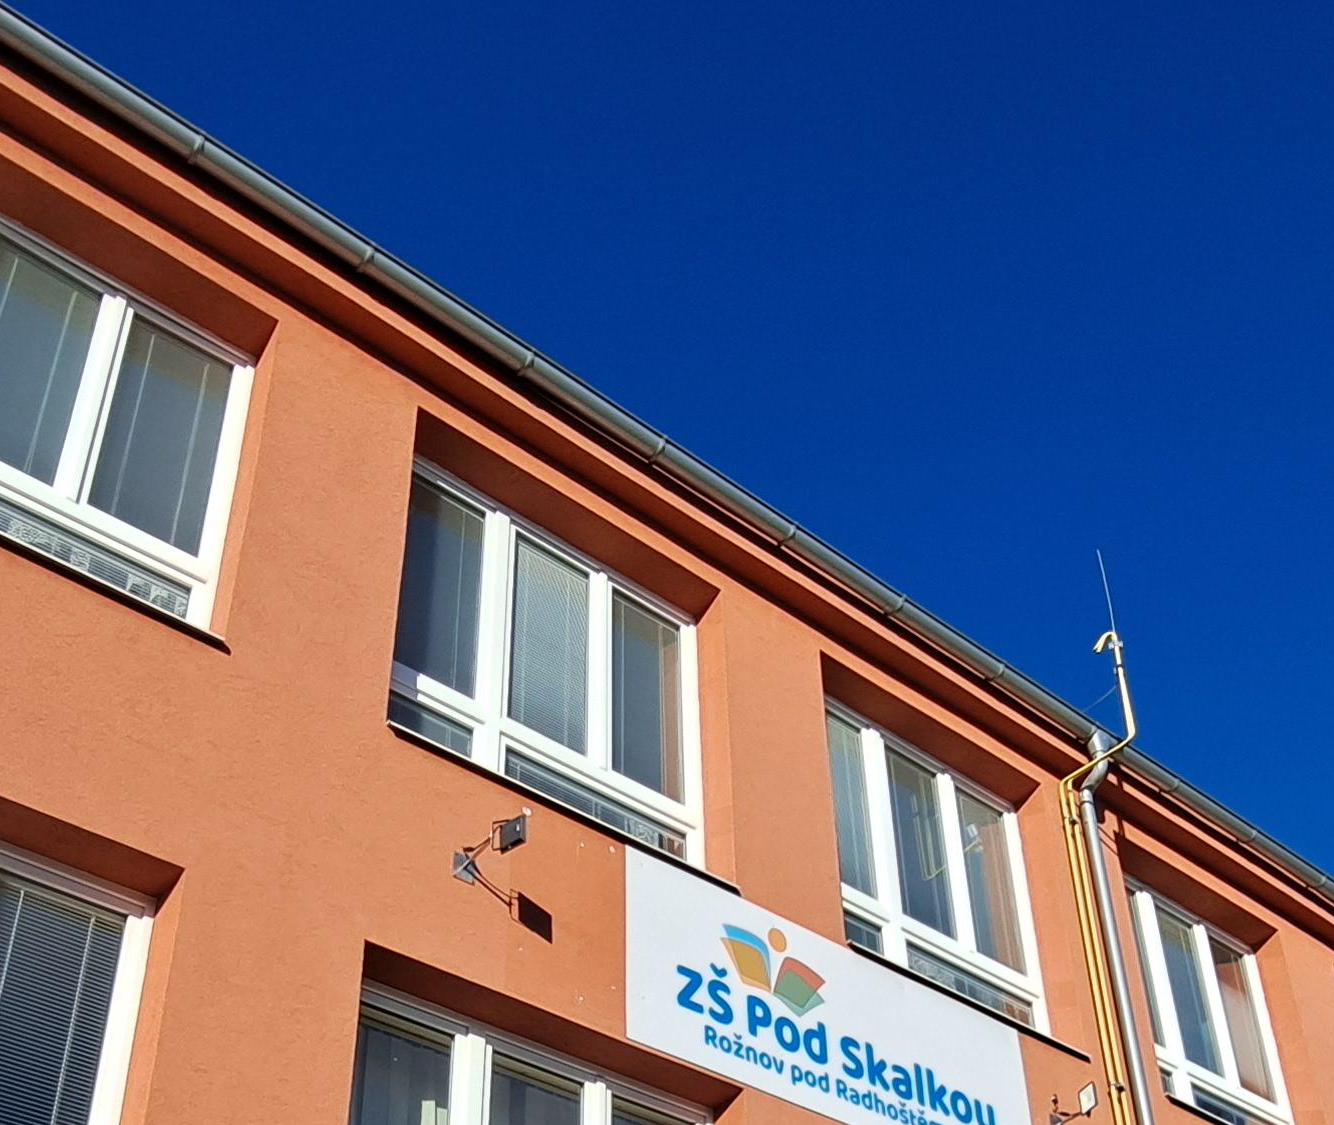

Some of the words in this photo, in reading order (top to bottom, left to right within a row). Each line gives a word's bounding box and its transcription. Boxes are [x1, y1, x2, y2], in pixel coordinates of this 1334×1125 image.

[675, 963, 735, 1026] ZŠ
[747, 994, 829, 1065] Pod
[704, 1025, 785, 1075] Rožnov
[791, 1064, 831, 1094] pod
